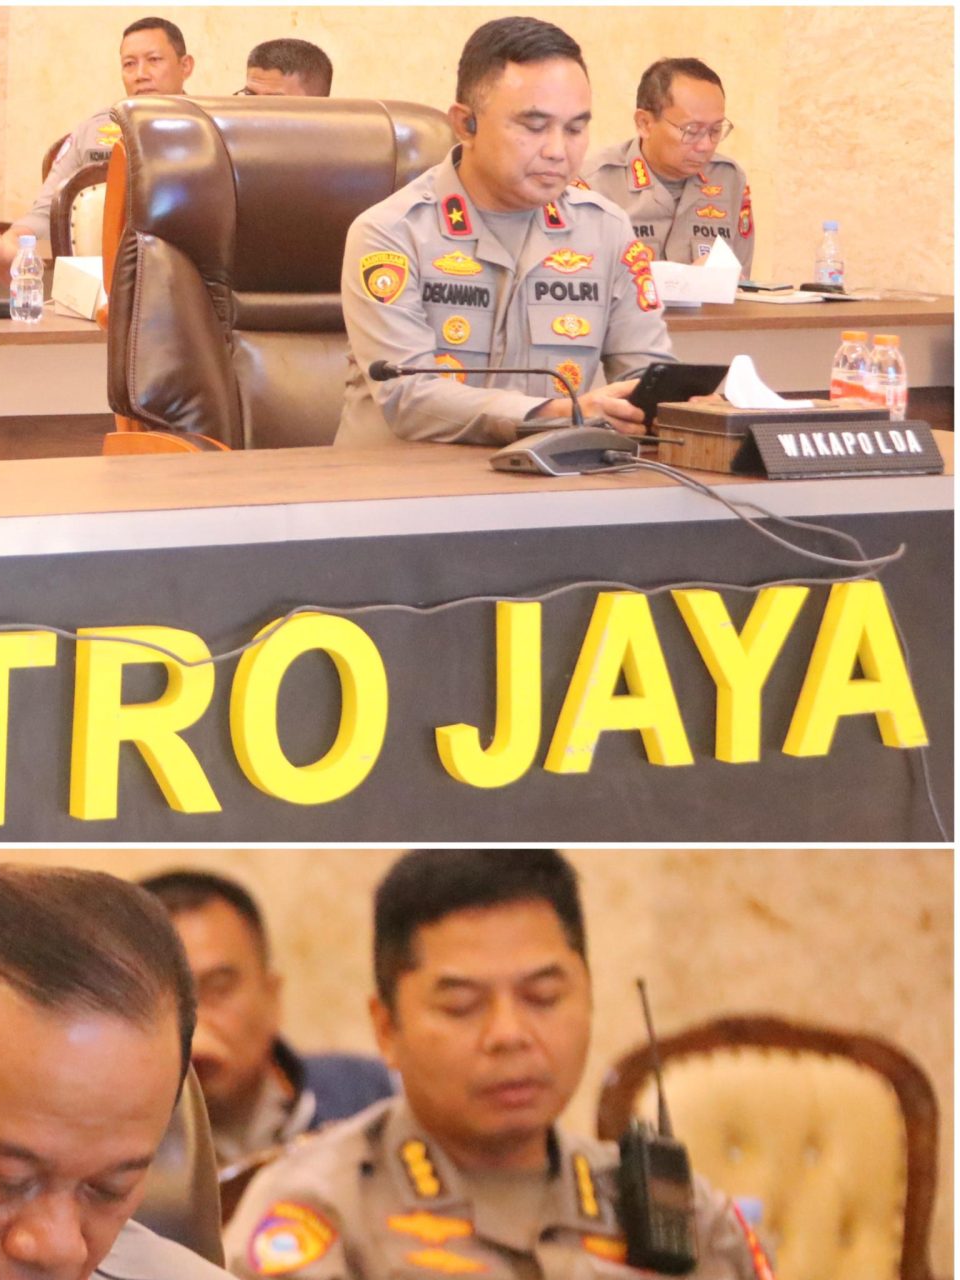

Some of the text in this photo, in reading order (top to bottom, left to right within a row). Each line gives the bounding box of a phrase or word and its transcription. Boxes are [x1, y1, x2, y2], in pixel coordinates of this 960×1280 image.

[693, 225, 731, 239] POLRI
[535, 281, 599, 301] POLRI
[777, 429, 923, 457] WAKAPOLDA
[435, 579, 930, 788] JAYA
